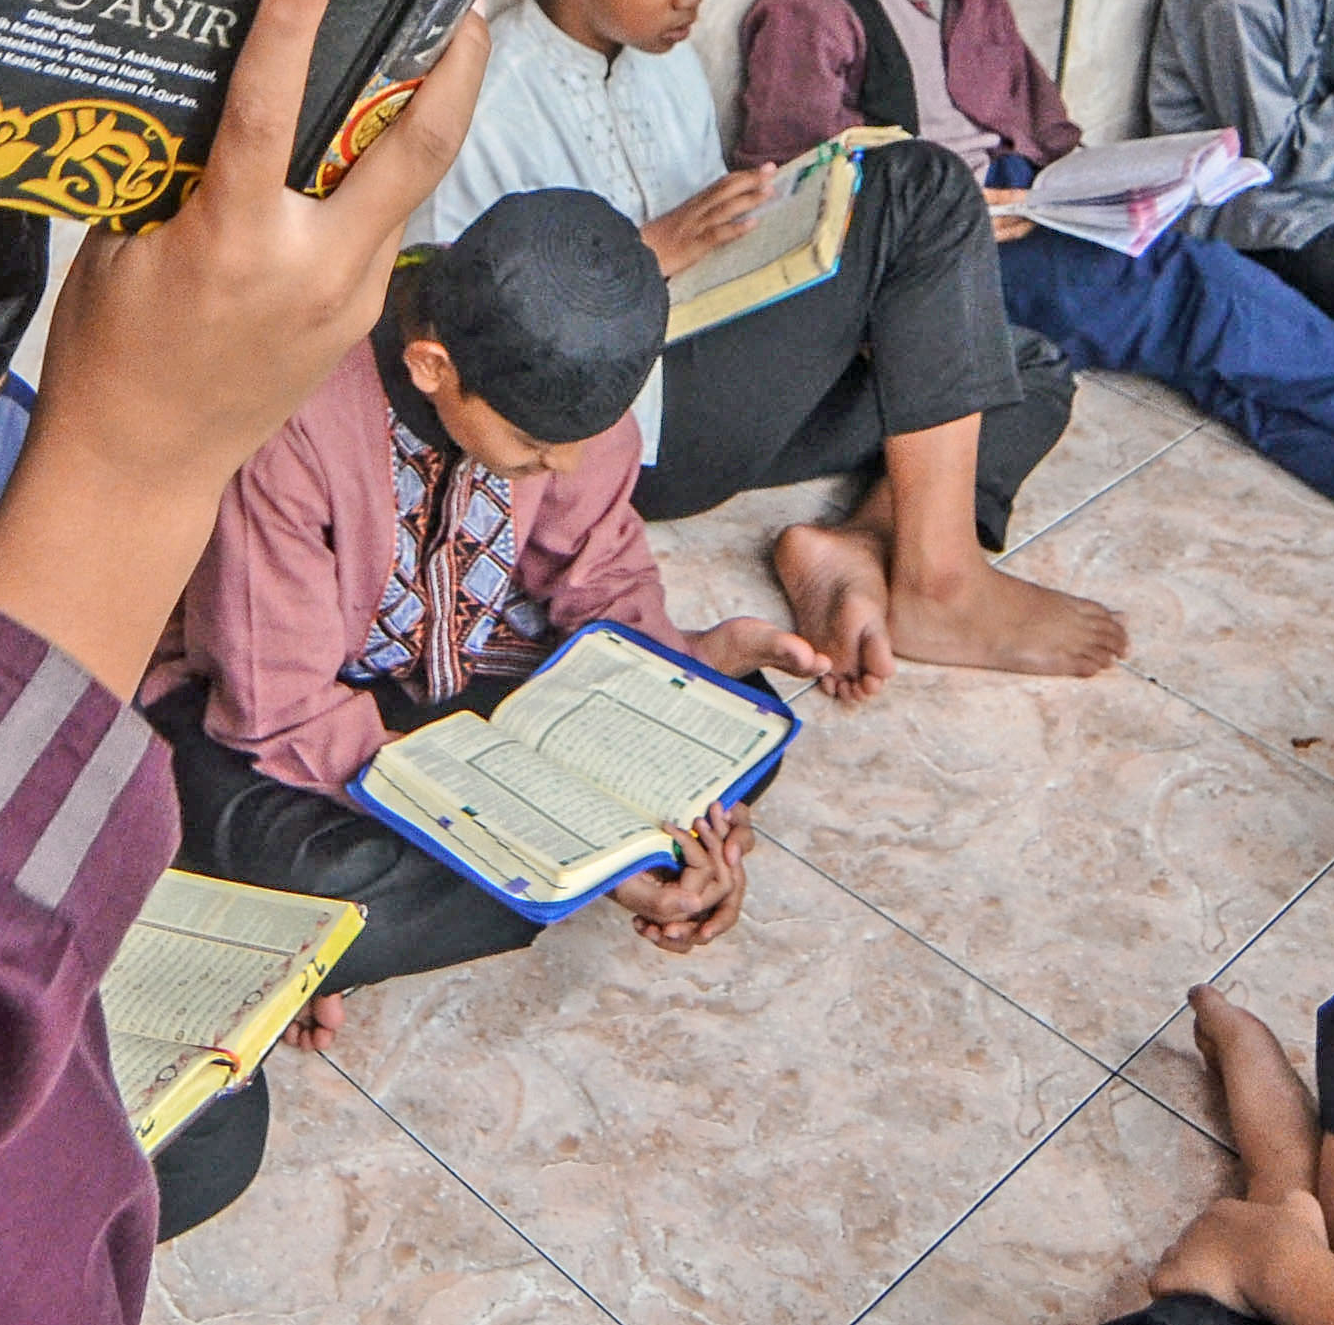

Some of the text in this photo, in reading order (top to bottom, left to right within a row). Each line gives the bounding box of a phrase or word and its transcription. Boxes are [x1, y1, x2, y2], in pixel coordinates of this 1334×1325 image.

[26, 8, 96, 36] Dilengkapi
[10, 21, 58, 43] Mudah
[58, 33, 122, 59] Dipahami,
[122, 49, 179, 72] Asbabun
[178, 63, 216, 83] Nuzul,
[67, 51, 117, 73] Mutiara
[117, 66, 157, 84] Hadis,
[43, 62, 70, 77] dan
[69, 68, 97, 84] Doa
[97, 77, 139, 94] dalam
